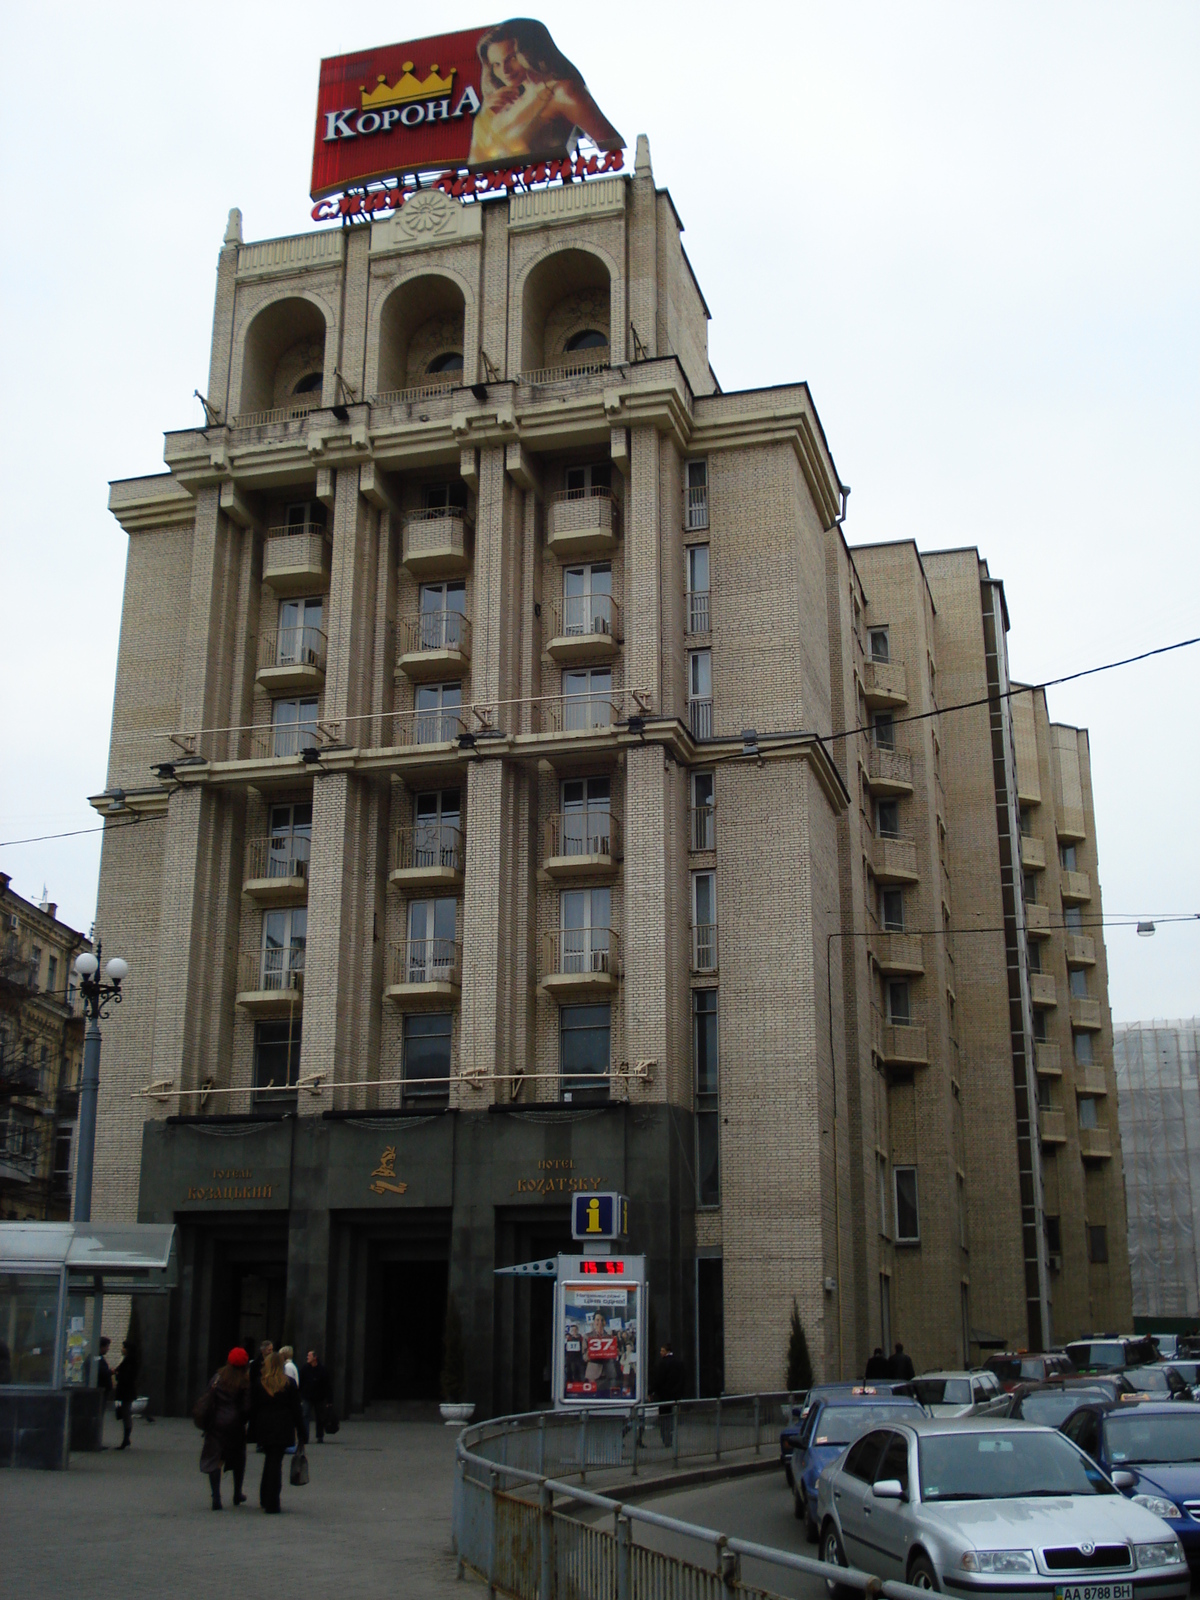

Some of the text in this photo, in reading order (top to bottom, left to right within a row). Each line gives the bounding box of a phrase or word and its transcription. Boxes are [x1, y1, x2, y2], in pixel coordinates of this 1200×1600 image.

[323, 85, 482, 142] КОРОНА
[538, 1160, 576, 1170] HOTEL
[589, 1338, 613, 1351] 37
[1064, 1588, 1081, 1600] AA
[1084, 1587, 1110, 1600] 8788
